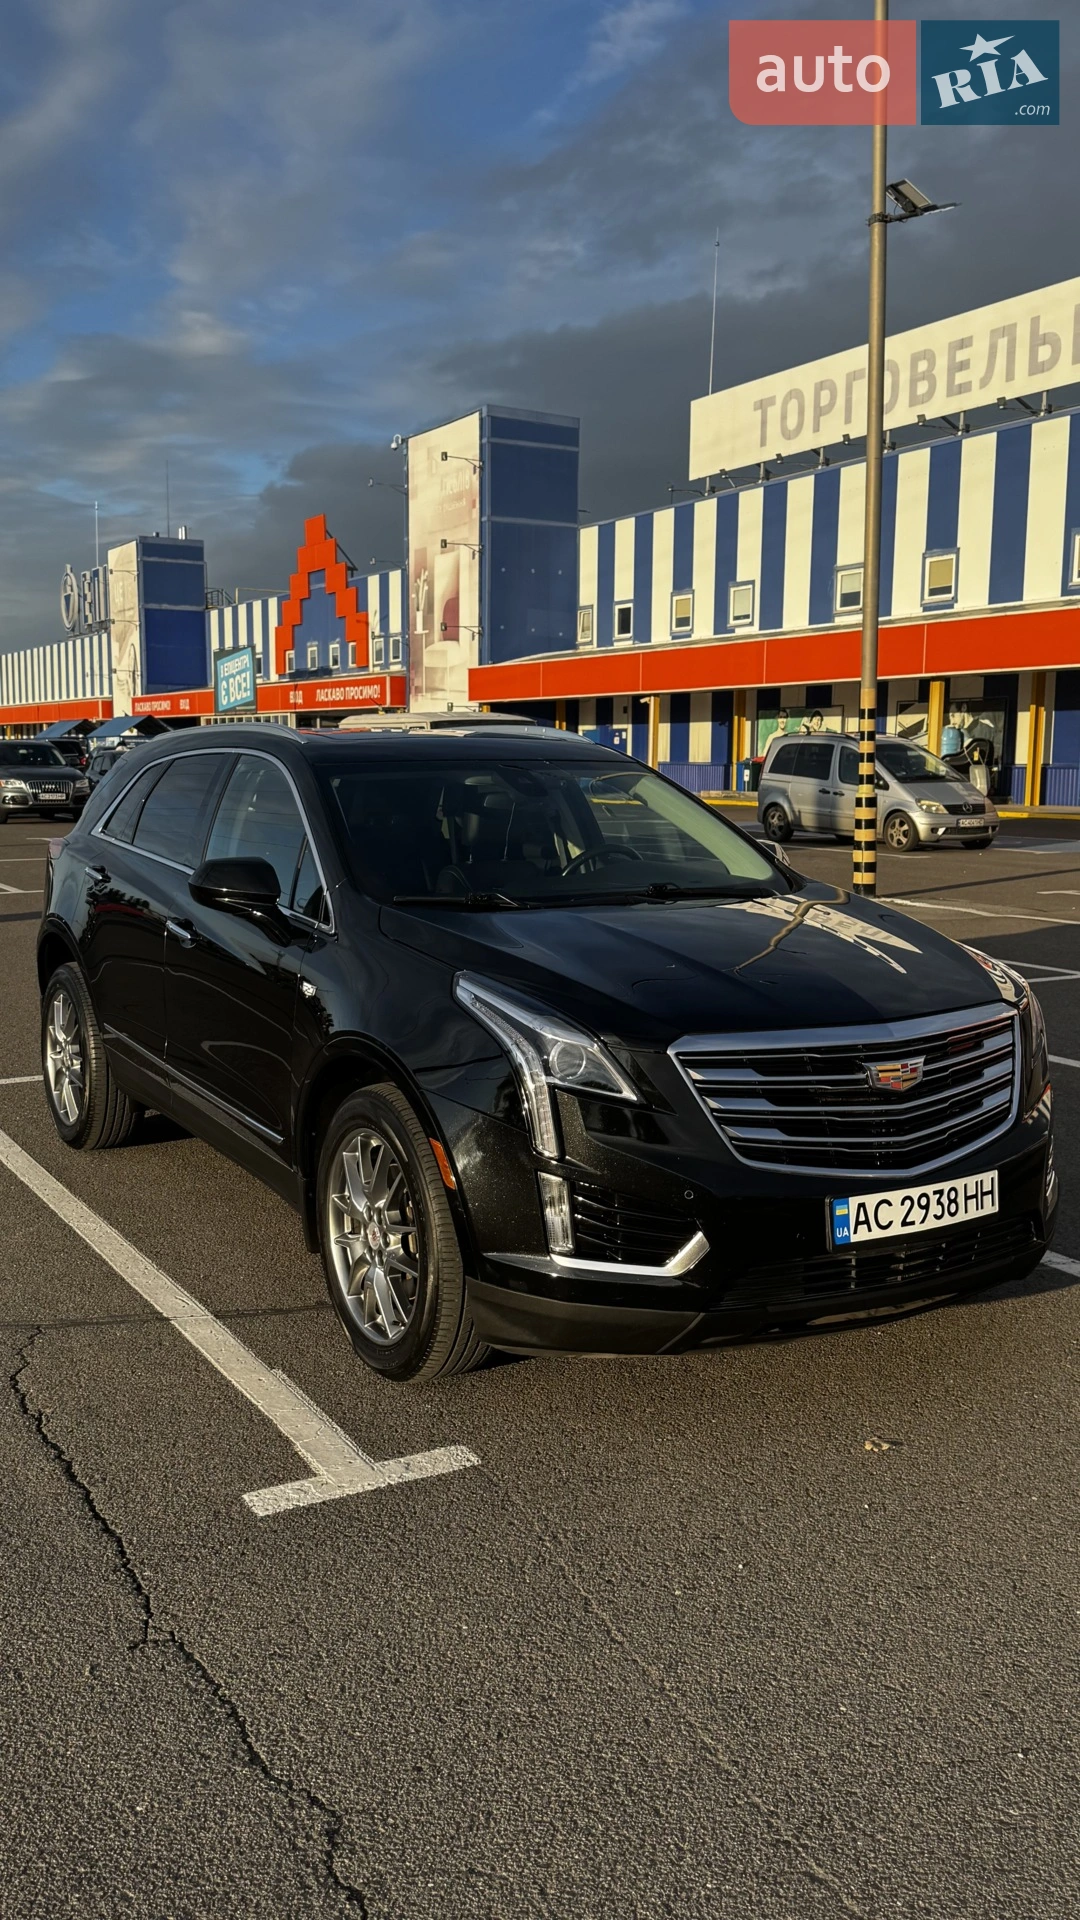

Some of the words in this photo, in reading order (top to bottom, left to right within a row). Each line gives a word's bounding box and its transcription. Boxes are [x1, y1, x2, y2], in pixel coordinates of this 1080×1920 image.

[753, 303, 1080, 448] ТОРГОВЕЛЬ
[221, 680, 228, 705] Є
[228, 670, 251, 703] ВСЕ!
[315, 687, 345, 702] ЛАСКАВО
[345, 683, 381, 700] ПРОСИМО!
[853, 1199, 894, 1235] AC
[900, 1187, 959, 1228] 2938
[963, 1177, 995, 1214] HH
[836, 1226, 850, 1238] UA
